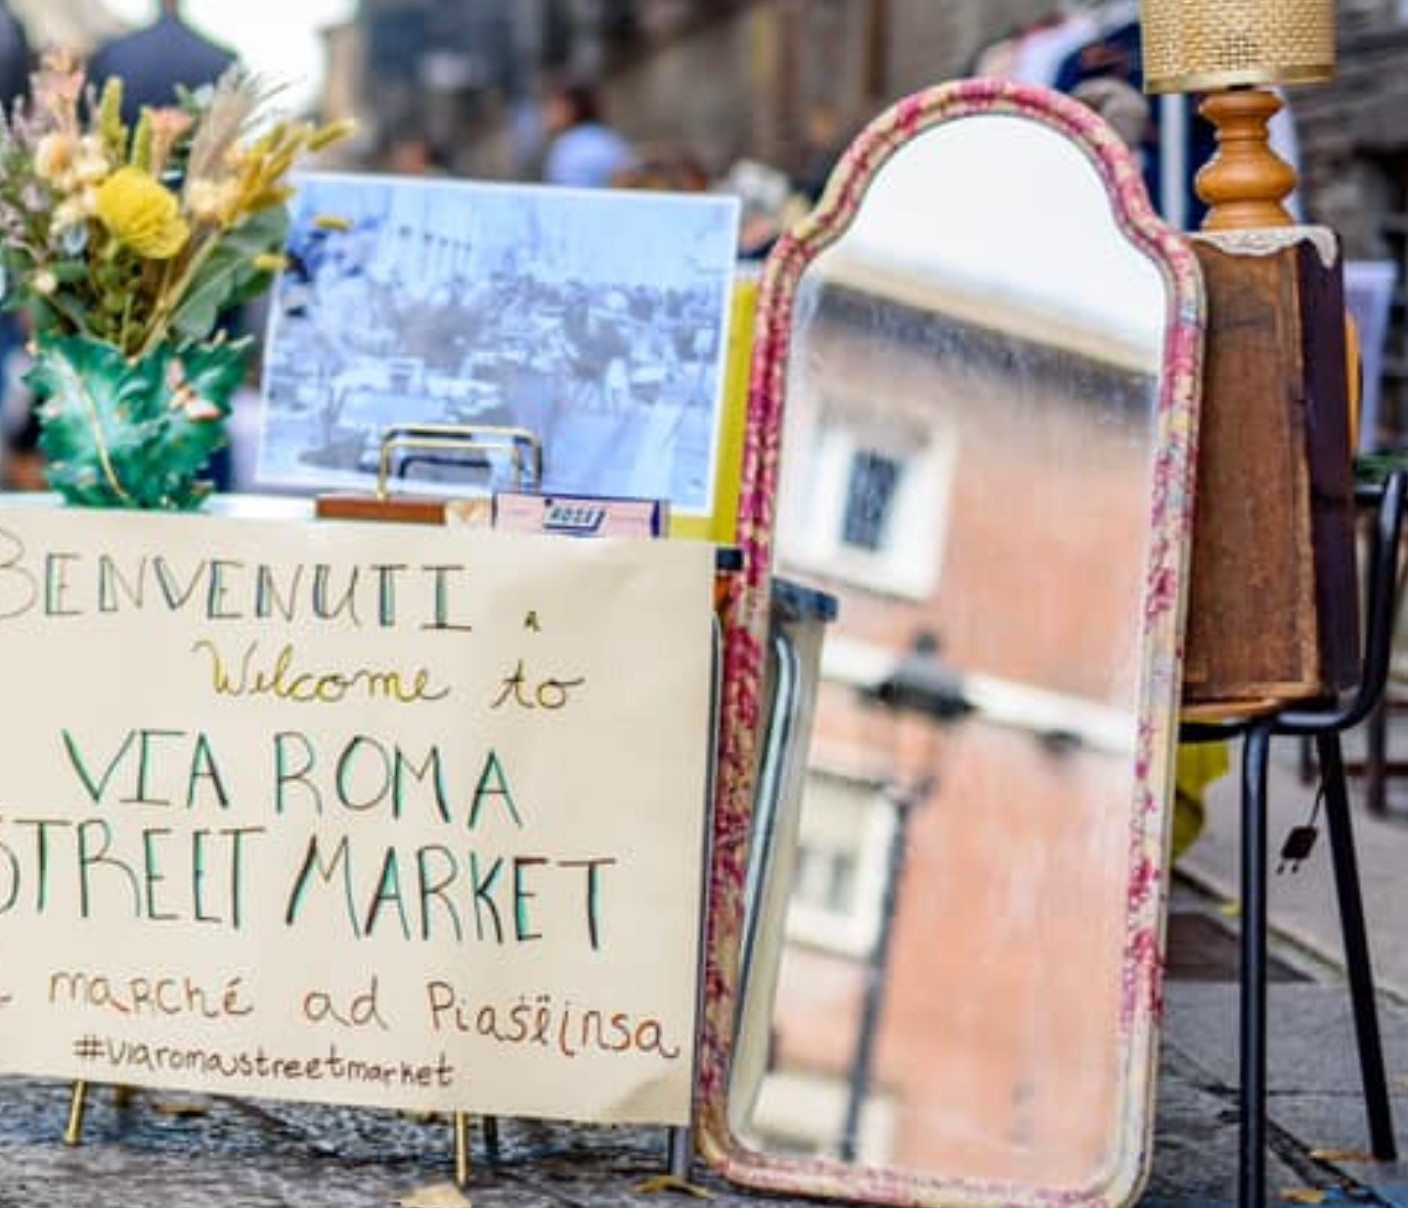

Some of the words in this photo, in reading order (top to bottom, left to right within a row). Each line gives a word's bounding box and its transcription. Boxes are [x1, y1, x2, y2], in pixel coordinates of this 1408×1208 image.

[193, 639, 450, 704] Welcome
[490, 659, 586, 710] to
[60, 728, 231, 810] VIA
[273, 730, 524, 831] ROMA
[284, 832, 617, 952] MARKET
[303, 975, 388, 1030] ad
